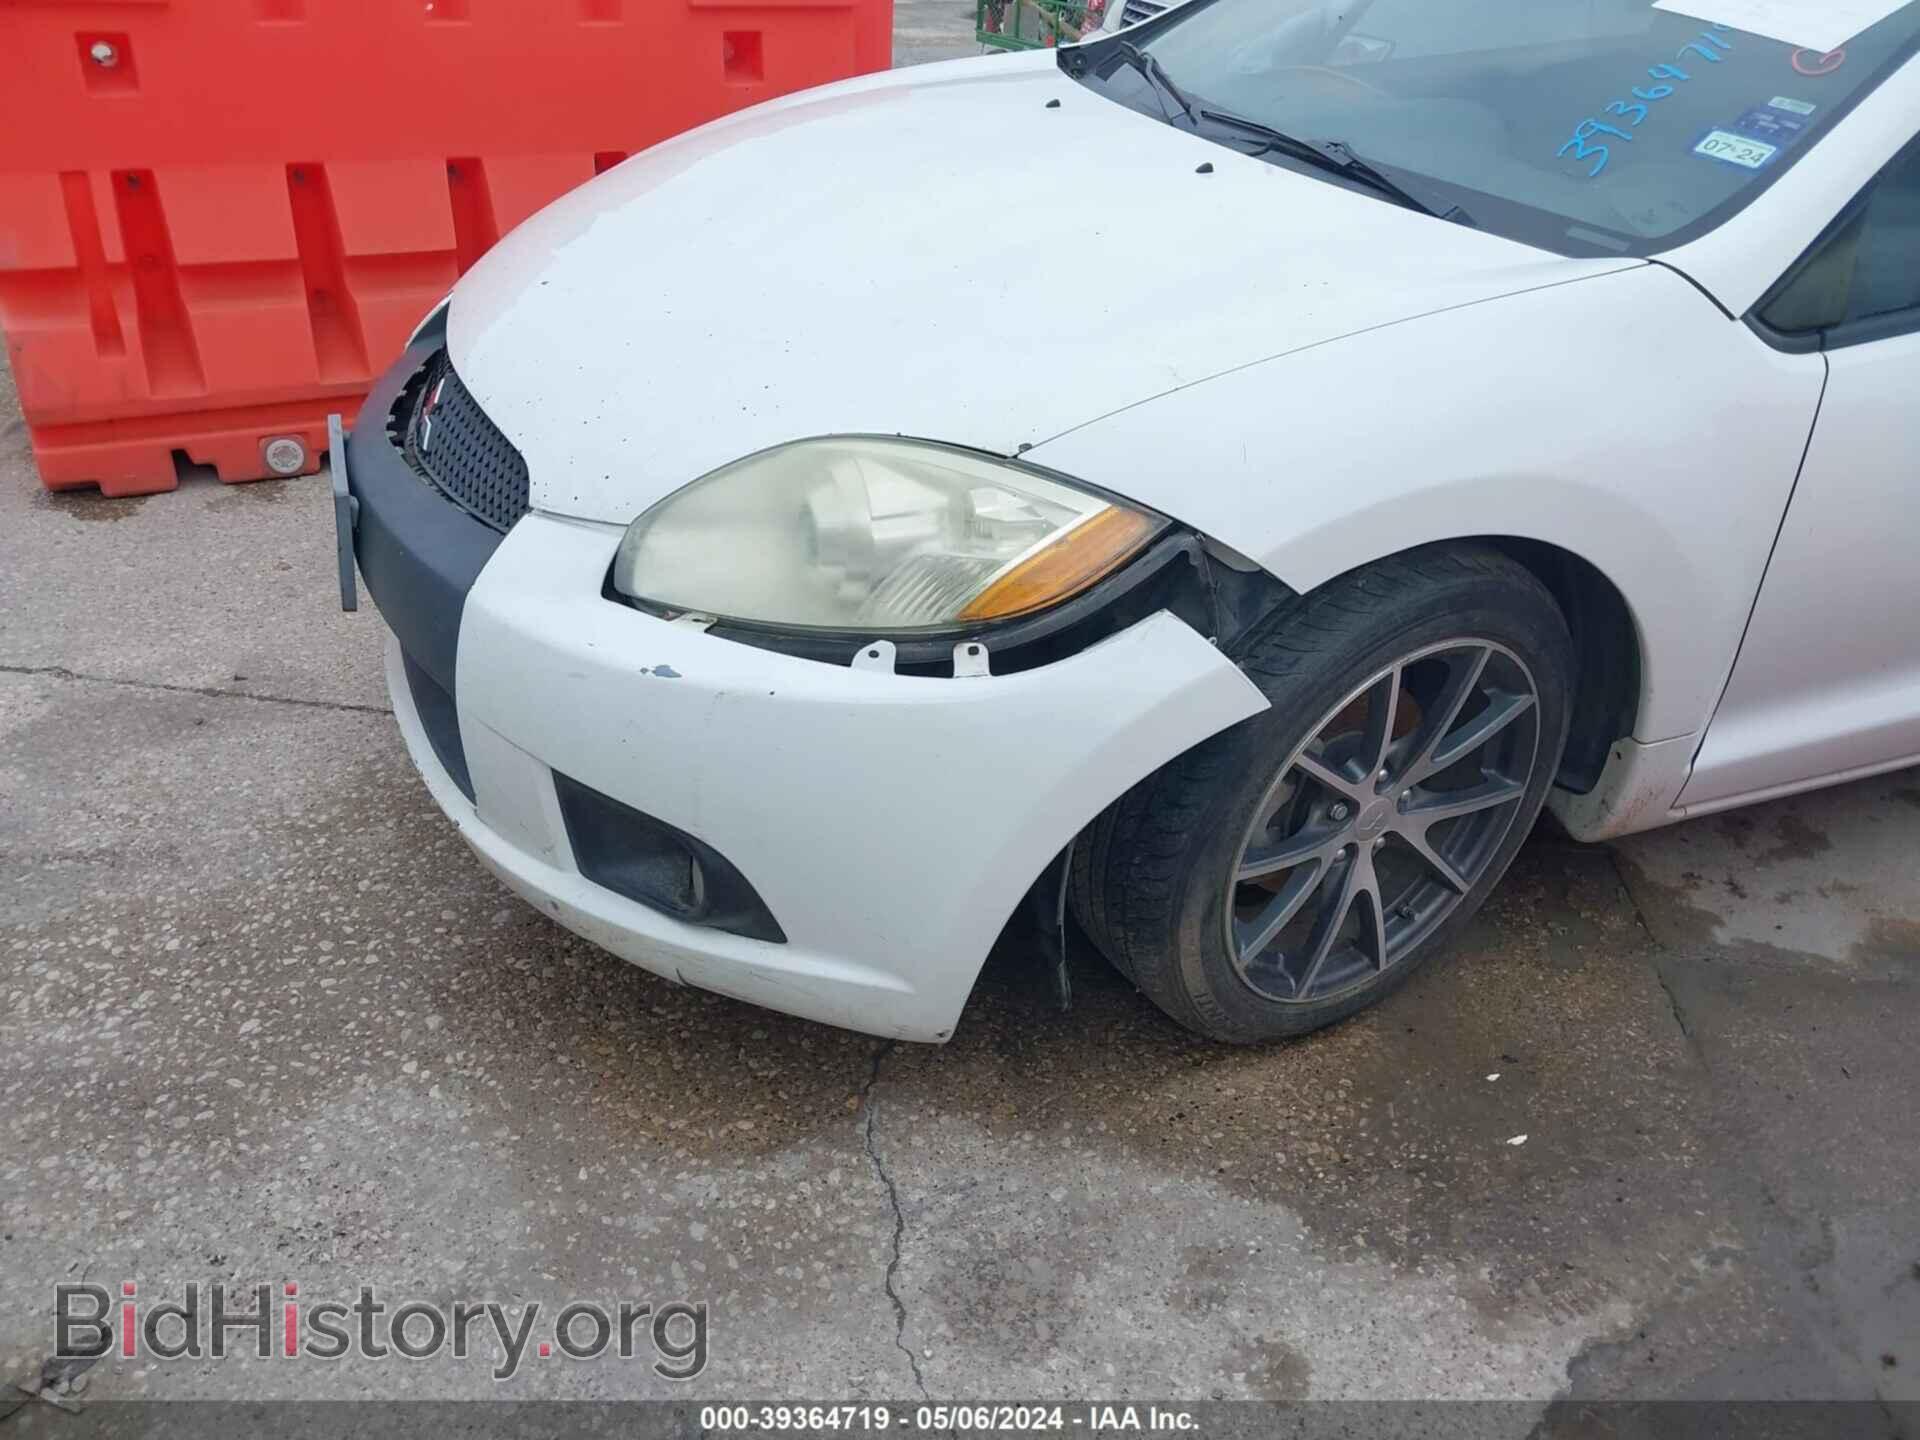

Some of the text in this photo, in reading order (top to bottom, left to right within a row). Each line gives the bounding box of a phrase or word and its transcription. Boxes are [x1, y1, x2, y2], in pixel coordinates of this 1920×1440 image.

[1557, 24, 1731, 177] 3936471
[1703, 139, 1731, 153] 07
[1735, 148, 1765, 163] 24
